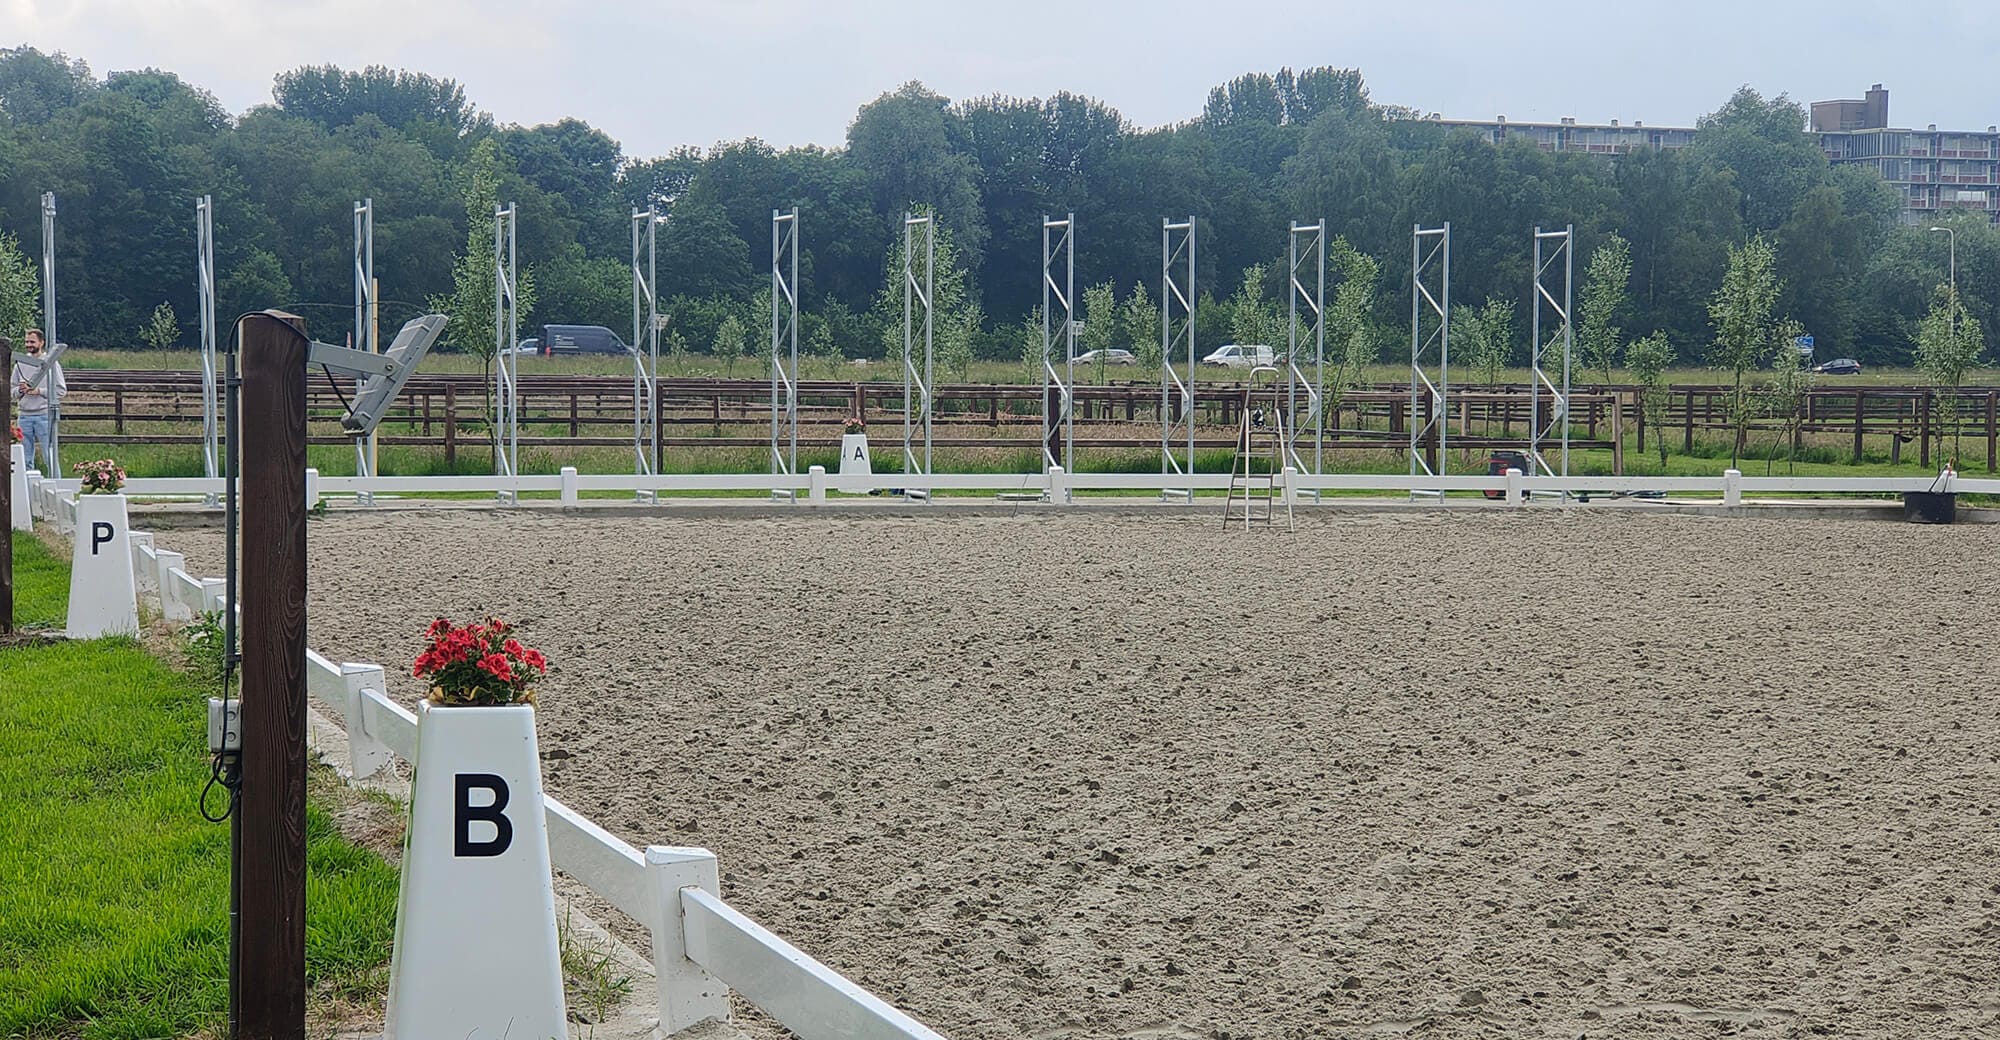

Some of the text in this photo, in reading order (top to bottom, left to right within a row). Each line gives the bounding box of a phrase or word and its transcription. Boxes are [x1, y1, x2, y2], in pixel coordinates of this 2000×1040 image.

[854, 446, 865, 460] A
[92, 522, 114, 555] P
[454, 773, 513, 857] B
